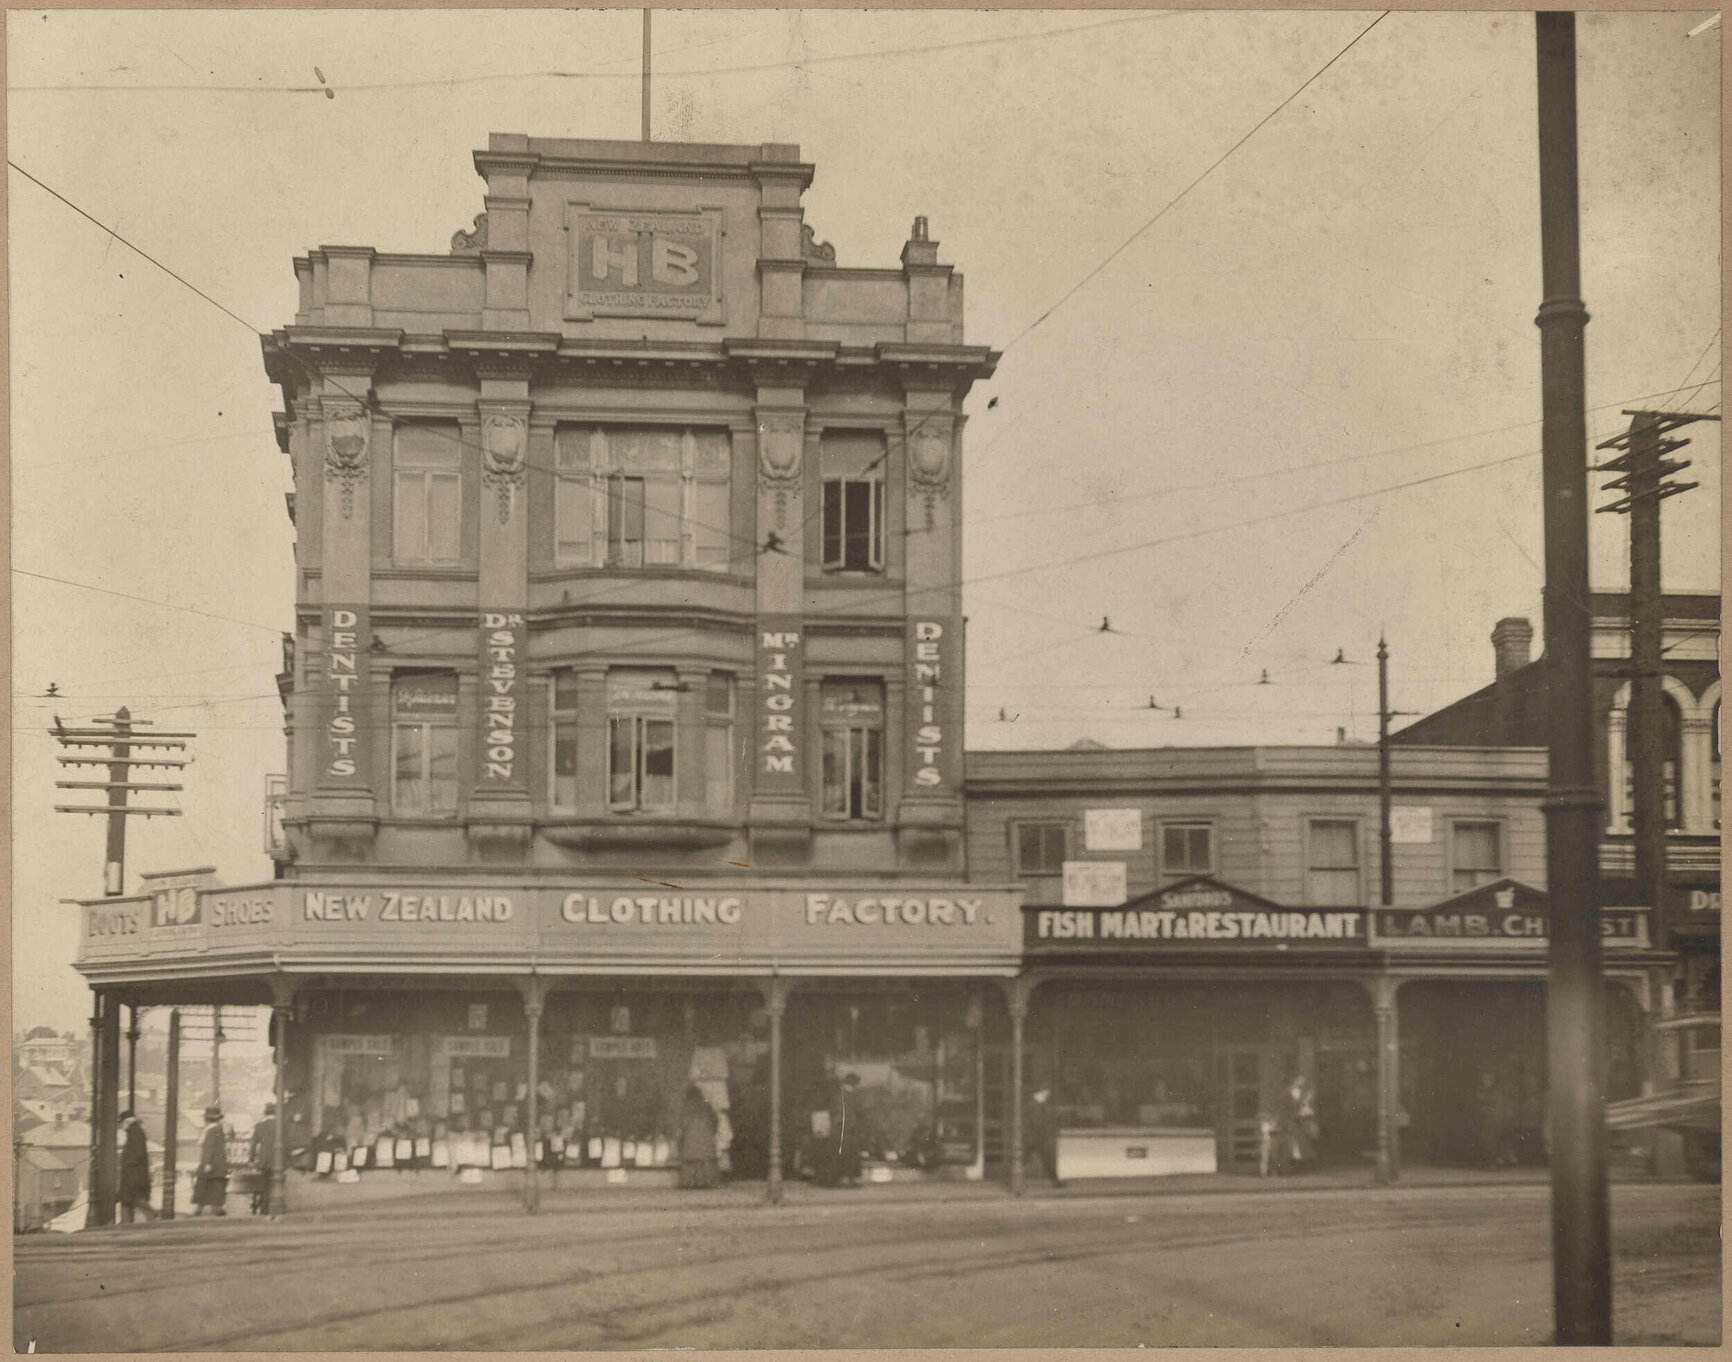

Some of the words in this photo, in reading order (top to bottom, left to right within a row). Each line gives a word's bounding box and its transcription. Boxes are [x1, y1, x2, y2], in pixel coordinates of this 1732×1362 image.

[585, 217, 621, 232] NEW
[628, 218, 705, 235] ZEALAND
[329, 610, 358, 776] DENTISTS
[486, 630, 516, 777] STEVENSON
[915, 622, 943, 786] DENTISTS
[762, 653, 795, 773] INGRAM
[157, 888, 196, 925] HB
[211, 898, 274, 927] SHOES
[303, 891, 371, 921] NEW
[379, 892, 514, 923] ZEALAND
[561, 892, 742, 925] CLOTHING
[1038, 911, 1094, 939] FISH
[1502, 914, 1633, 938] CHST
